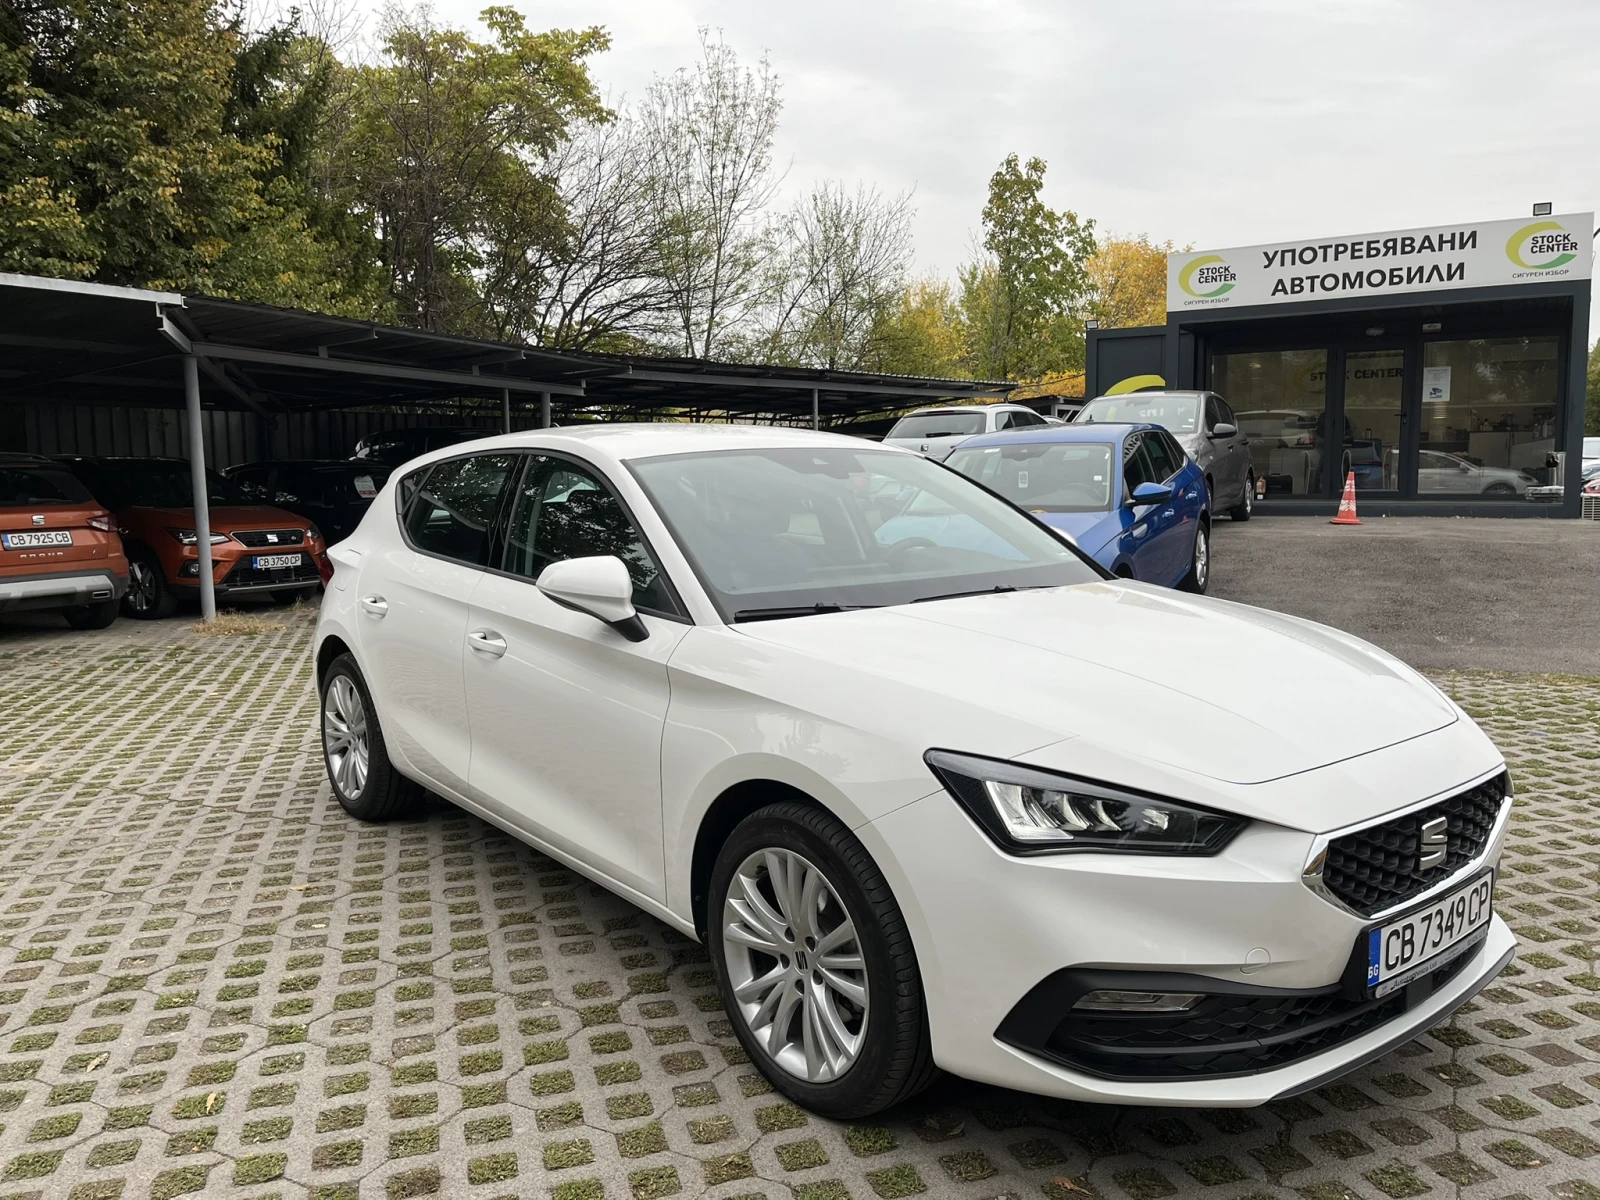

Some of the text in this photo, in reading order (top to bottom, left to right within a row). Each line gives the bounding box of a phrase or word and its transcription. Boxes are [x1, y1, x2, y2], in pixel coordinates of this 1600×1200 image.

[1531, 233, 1571, 245] STOCK
[1262, 230, 1477, 269] УПОТРЕБЯВАНИ
[1530, 242, 1578, 254] CENTER
[1198, 265, 1231, 276] STOCK
[1512, 271, 1544, 279] СИГУРЕН
[1198, 273, 1237, 284] CENTER
[1271, 262, 1465, 296] АВТОМОБИЛИ
[1354, 367, 1404, 380] CENTER
[10, 535, 26, 546] CB
[26, 533, 54, 545] 7925
[270, 556, 289, 567] 3750
[1385, 922, 1415, 971] CB
[1419, 898, 1466, 957] 7349
[1468, 880, 1489, 926] CP
